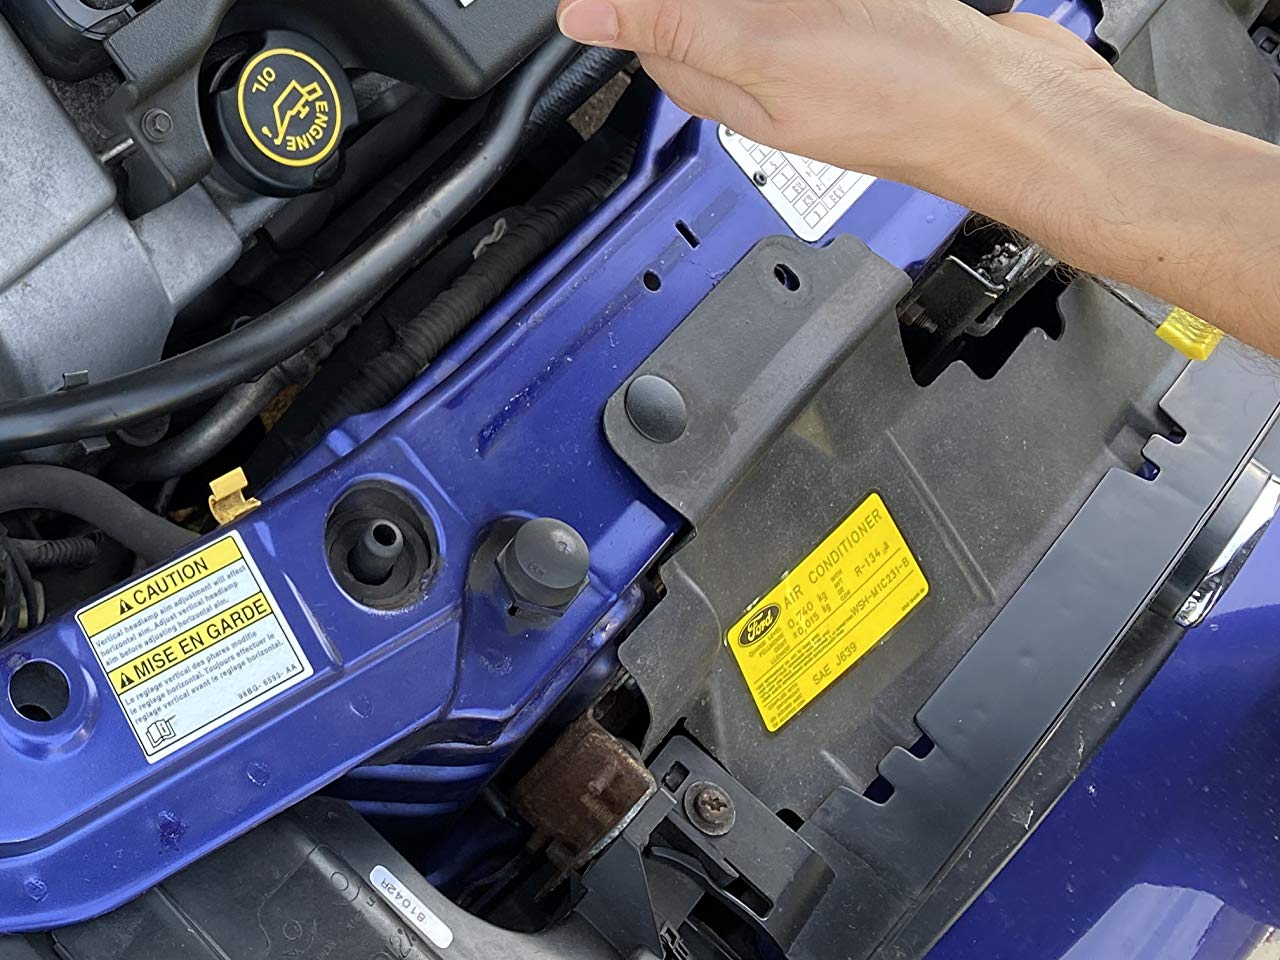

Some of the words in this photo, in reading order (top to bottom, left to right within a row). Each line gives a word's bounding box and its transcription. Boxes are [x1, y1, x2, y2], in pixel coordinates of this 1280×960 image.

[251, 66, 276, 93] OIL
[284, 100, 329, 151] ENGINE
[131, 555, 209, 607] CAUTION
[784, 584, 803, 609] AIR
[807, 508, 882, 584] CONDITIONER
[850, 556, 909, 616] WSH-M1C231-B
[95, 628, 124, 648] Vertical
[124, 610, 159, 634] headlamp
[159, 603, 173, 614] aim
[173, 582, 213, 608] adjustment
[211, 574, 226, 586] will
[225, 564, 247, 580] affect
[100, 633, 137, 657] horizontal
[153, 611, 178, 630] Adjust
[177, 597, 204, 616] vertical
[204, 579, 239, 603] headlamp
[747, 609, 774, 641] Ford
[816, 591, 827, 601] kg
[821, 603, 831, 612] kg
[105, 655, 119, 666] aim
[118, 641, 143, 659] before
[143, 623, 177, 647] adjusting
[176, 604, 213, 628] horizontal
[132, 645, 177, 679] MISE
[177, 631, 205, 655] EN
[204, 597, 267, 641] GARDE
[812, 664, 831, 685] SAE
[834, 641, 857, 666] J639
[124, 696, 135, 706] Le
[135, 680, 164, 702] reglage
[163, 665, 191, 685] vertical
[191, 658, 205, 670] des
[205, 644, 231, 663] phares
[230, 630, 257, 649] modifie
[128, 706, 137, 715] le
[137, 691, 167, 711] reglage
[166, 670, 204, 695] horizontal.
[204, 653, 236, 675] Toujours
[235, 636, 267, 658] effectuer
[266, 631, 275, 640] le
[133, 704, 162, 725] reglage
[161, 689, 190, 709] vertical
[190, 678, 210, 694] avant
[210, 673, 219, 683] le
[218, 659, 247, 679] reglage
[246, 638, 284, 663] horizontal.
